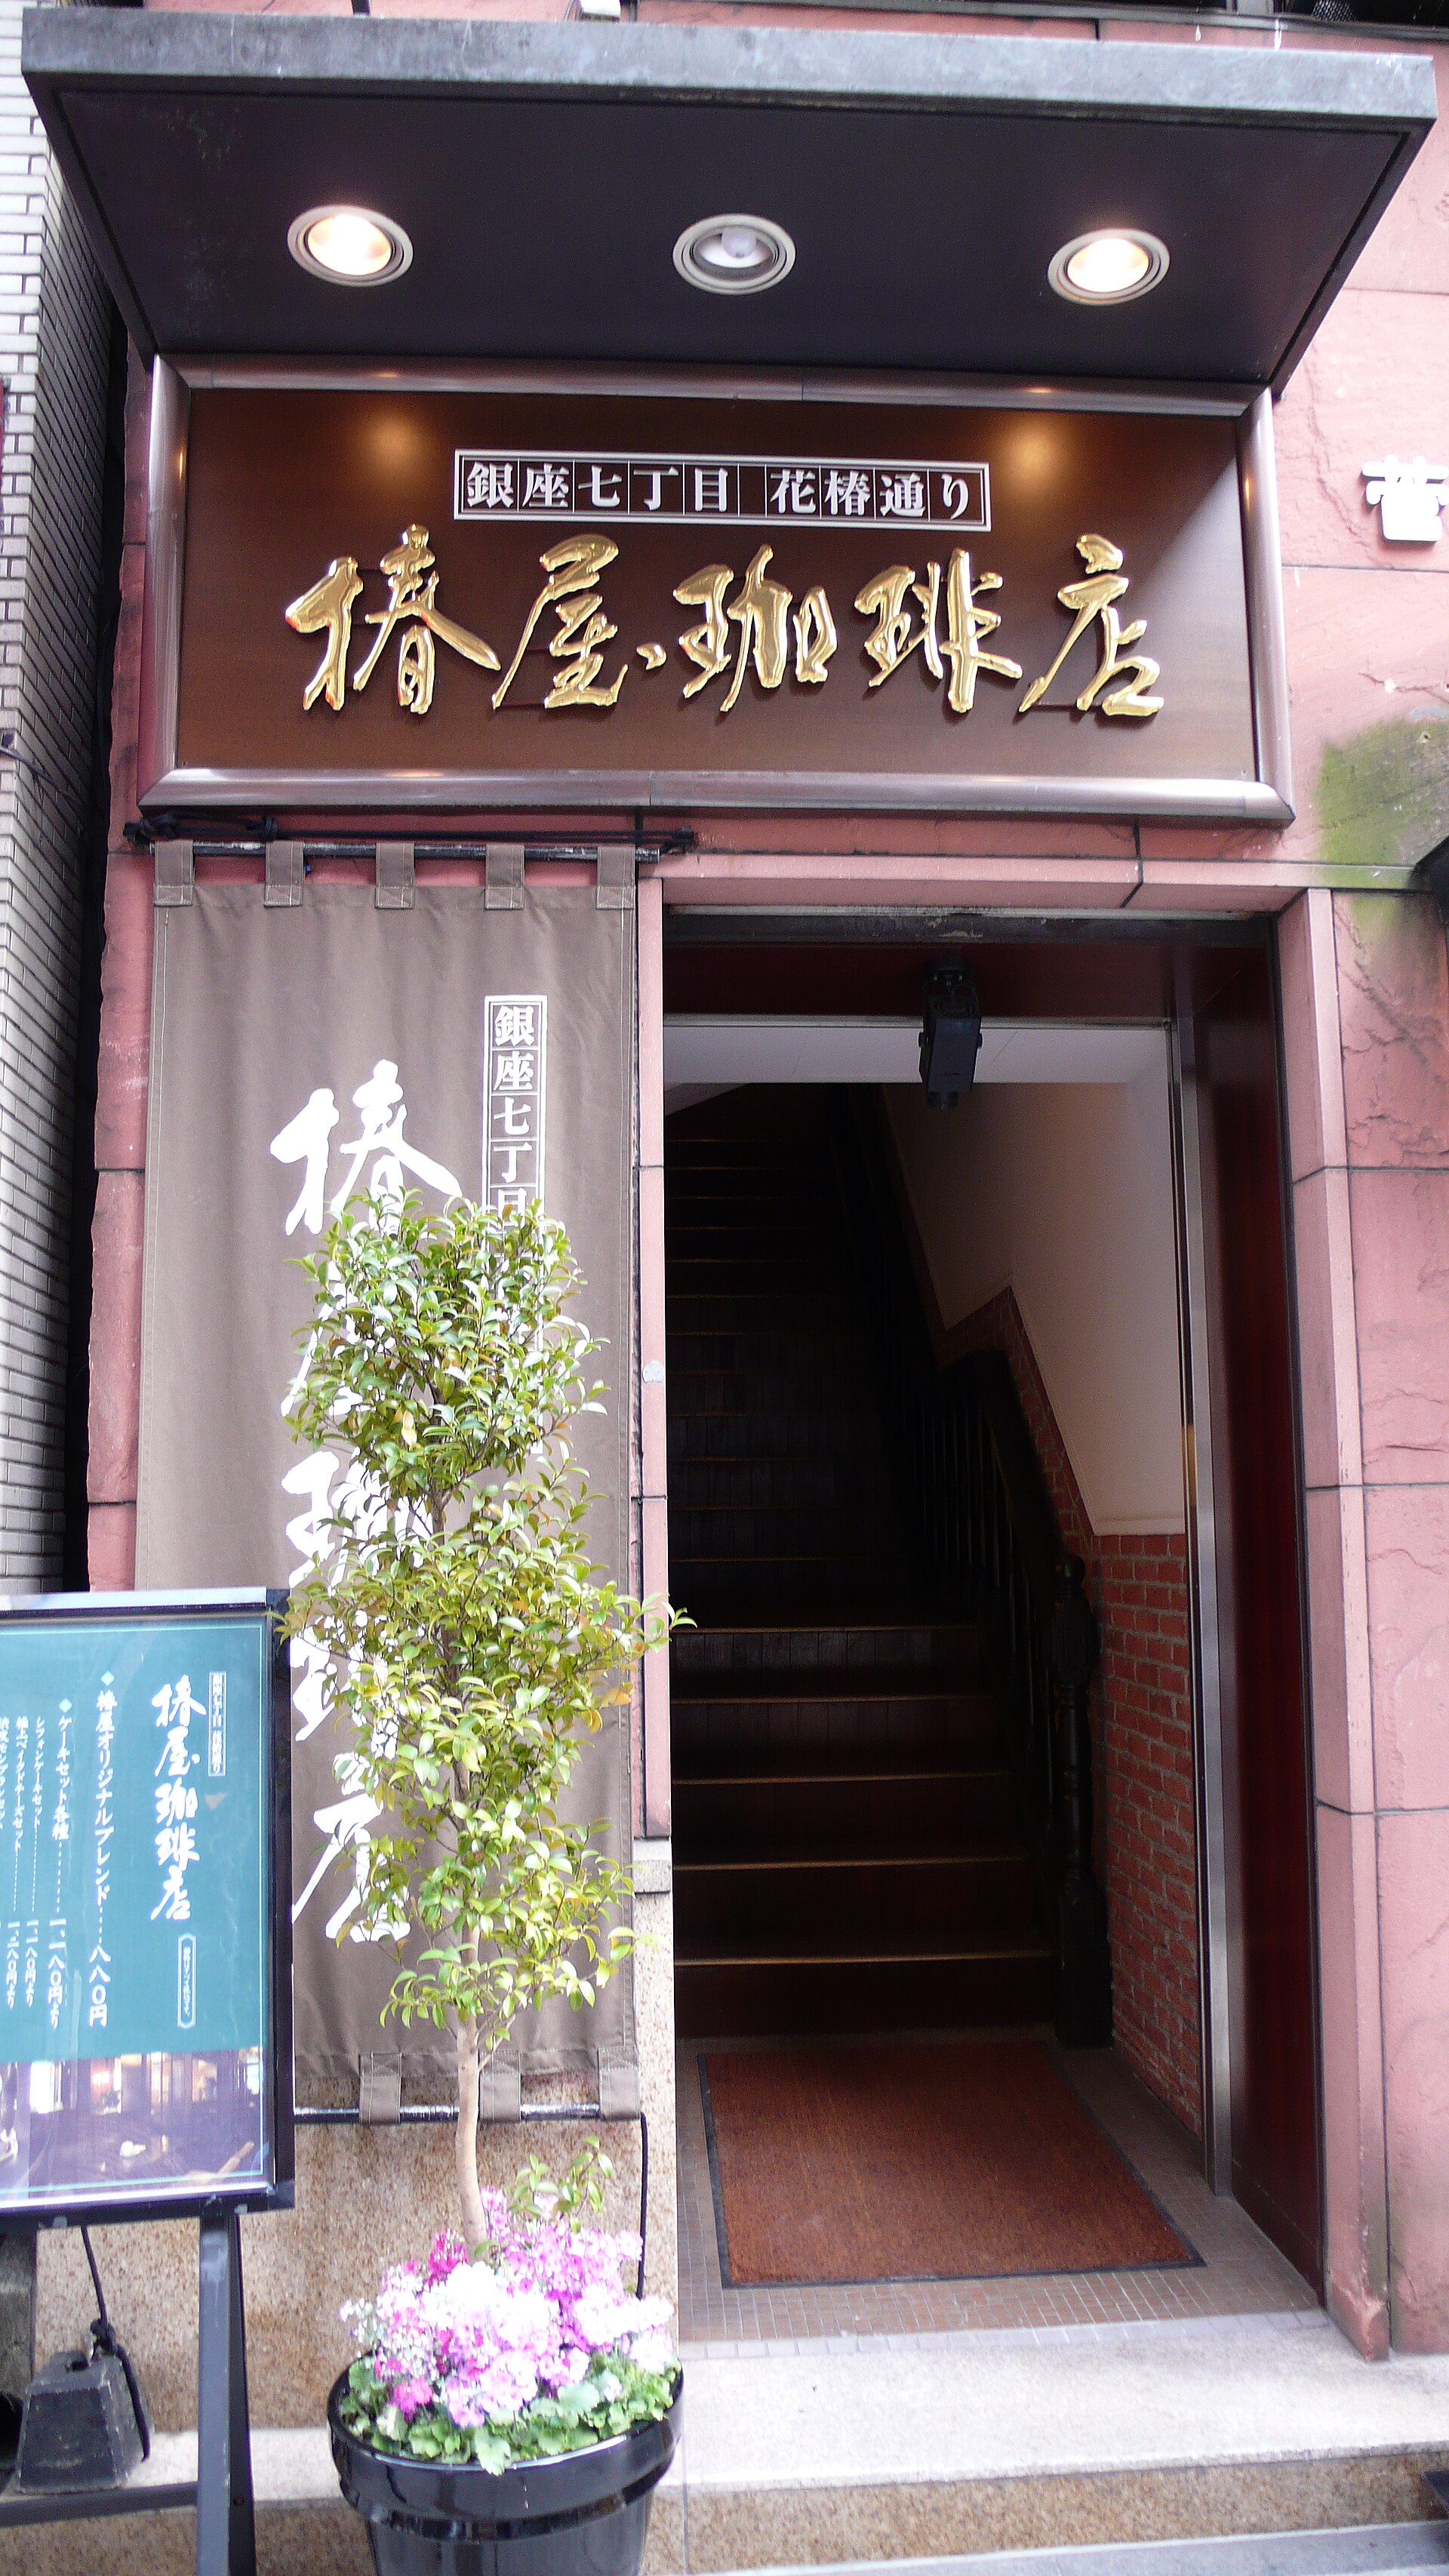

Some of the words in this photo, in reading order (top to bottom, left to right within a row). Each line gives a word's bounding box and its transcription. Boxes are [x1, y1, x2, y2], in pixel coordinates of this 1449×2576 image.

[466, 463, 729, 511] 銀座七丁目
[769, 469, 969, 520] 花椿通り
[285, 524, 1164, 716] 椿屋珈琲店
[150, 1674, 206, 1921] 椿屋珈琲店
